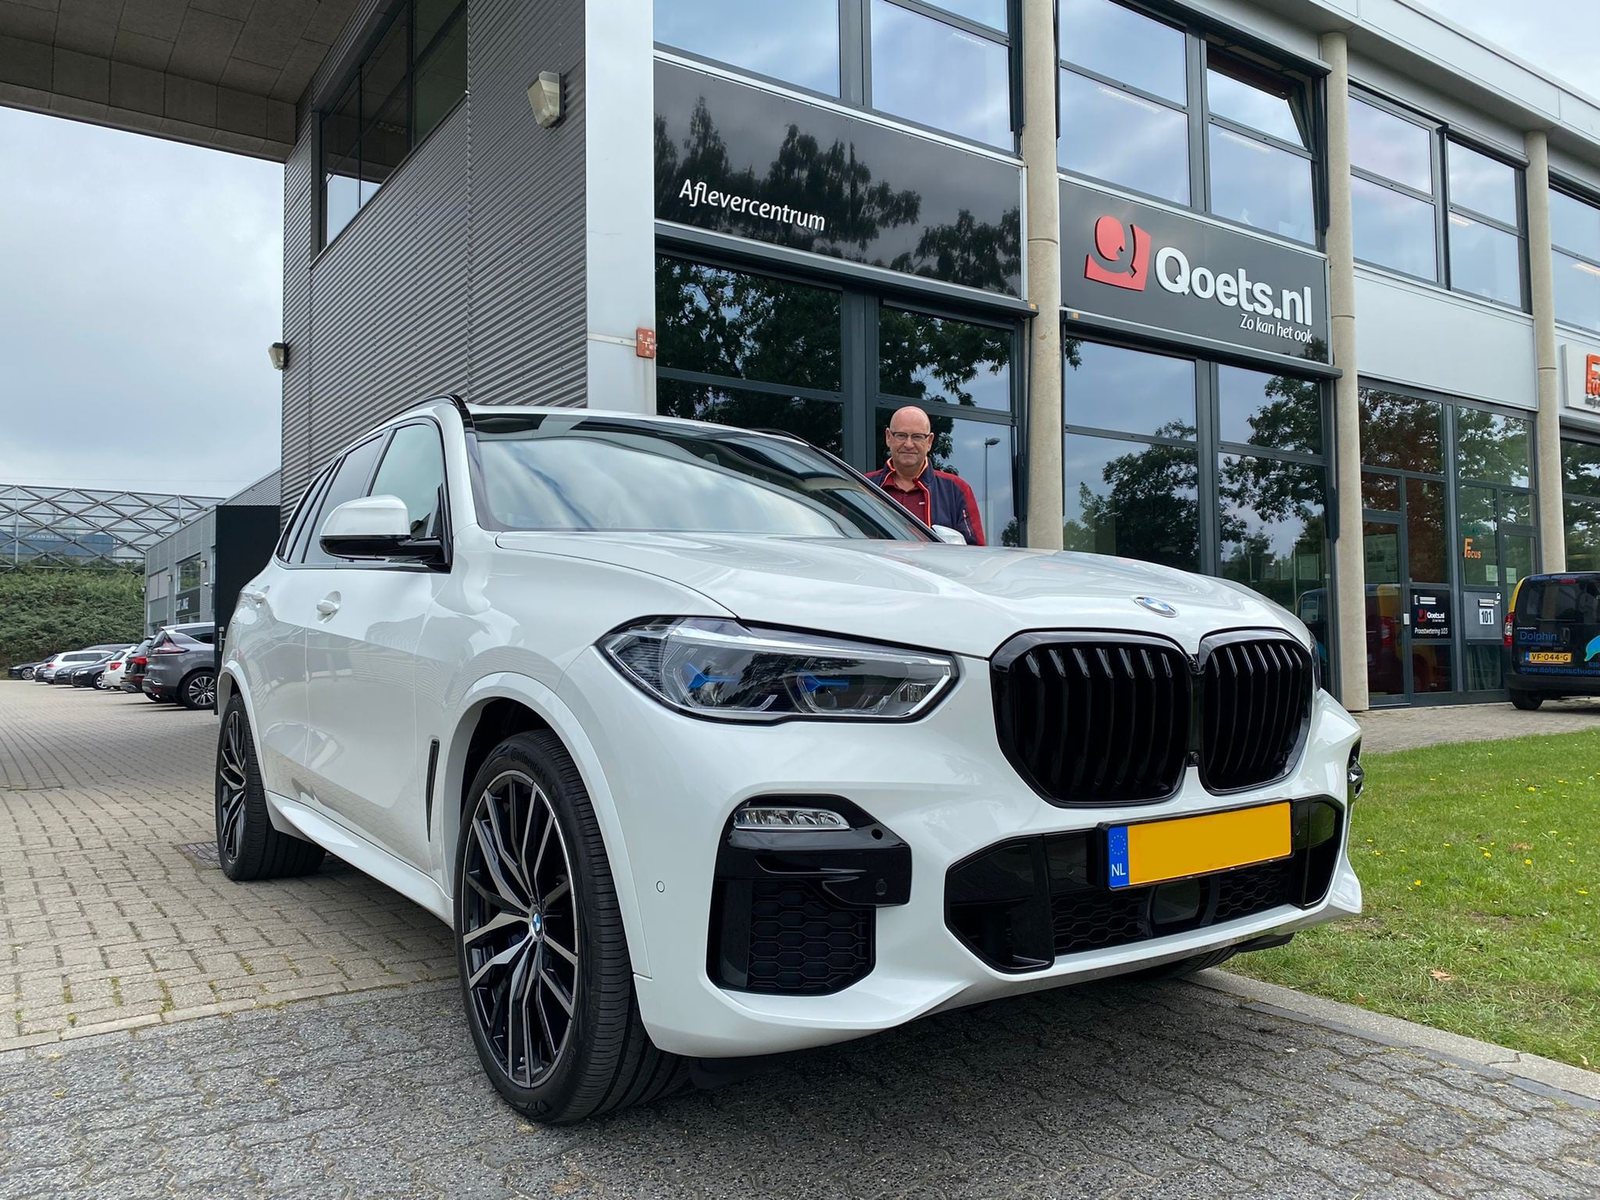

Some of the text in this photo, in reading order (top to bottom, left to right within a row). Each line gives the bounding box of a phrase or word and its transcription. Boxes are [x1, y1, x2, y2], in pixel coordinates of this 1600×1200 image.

[679, 178, 825, 231] Aflevercentrum
[1155, 246, 1312, 326] Qoets.nl
[1240, 313, 1313, 344] Zo kan het ook
[1481, 610, 1492, 624] 101
[1520, 631, 1557, 642] Dolphin
[1111, 863, 1126, 877] NL
